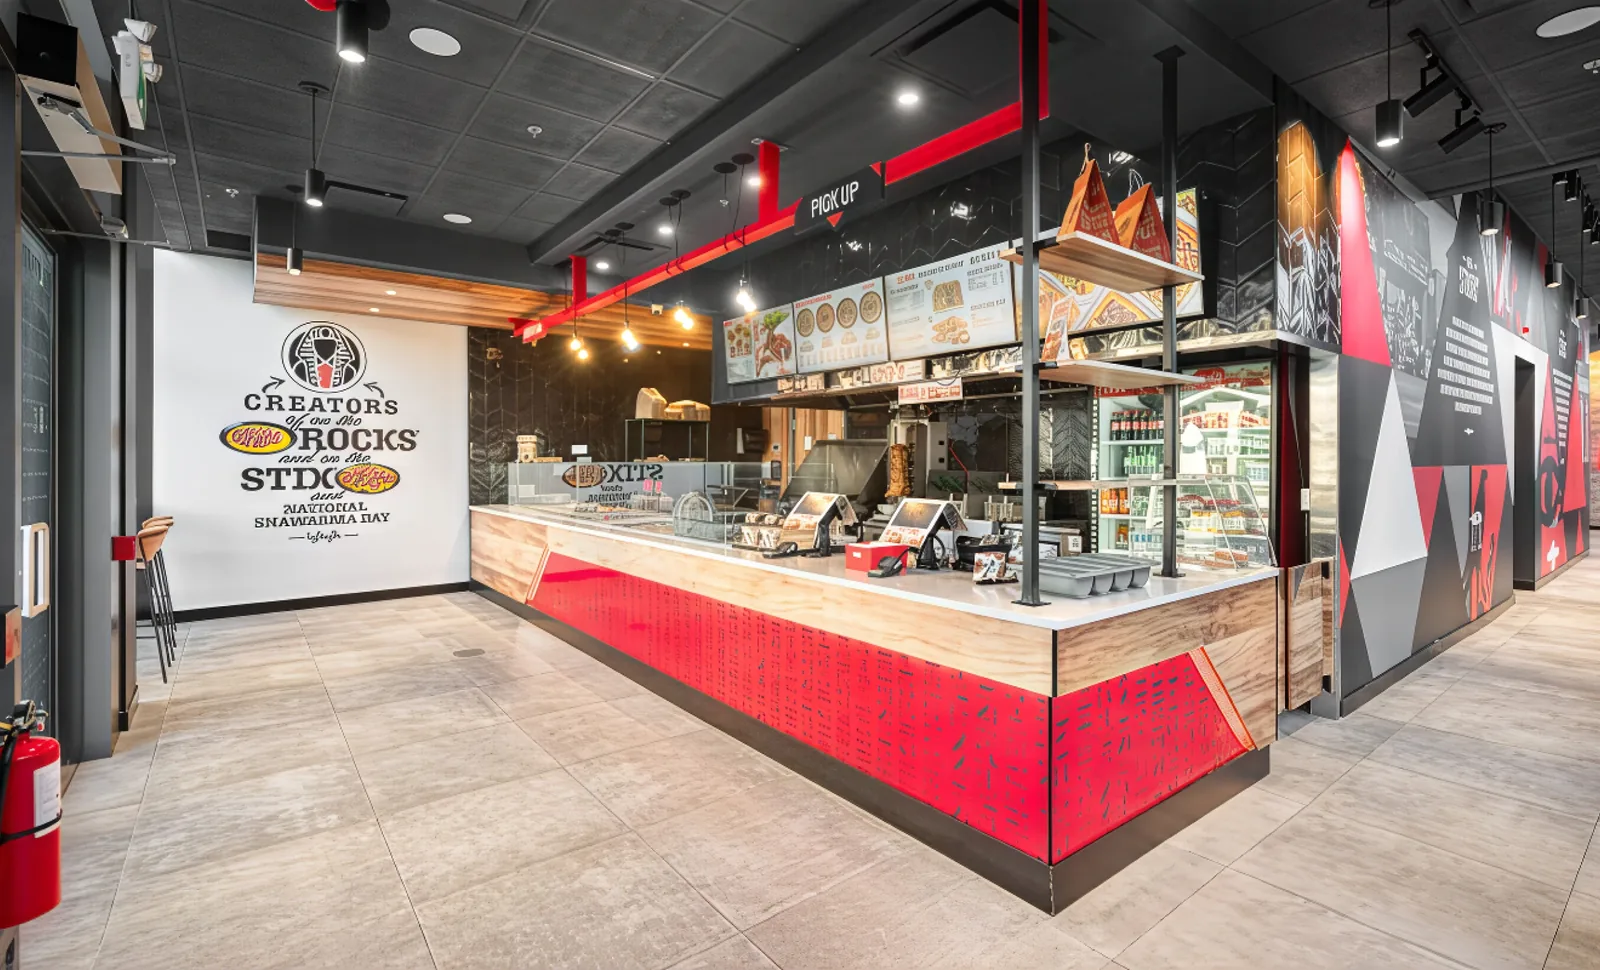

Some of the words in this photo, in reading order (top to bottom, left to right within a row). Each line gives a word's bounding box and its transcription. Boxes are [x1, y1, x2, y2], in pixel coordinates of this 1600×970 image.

[811, 187, 840, 219] PICK
[840, 181, 859, 205] UP
[243, 393, 399, 415] CREATORS
[298, 427, 418, 451] ROCKS
